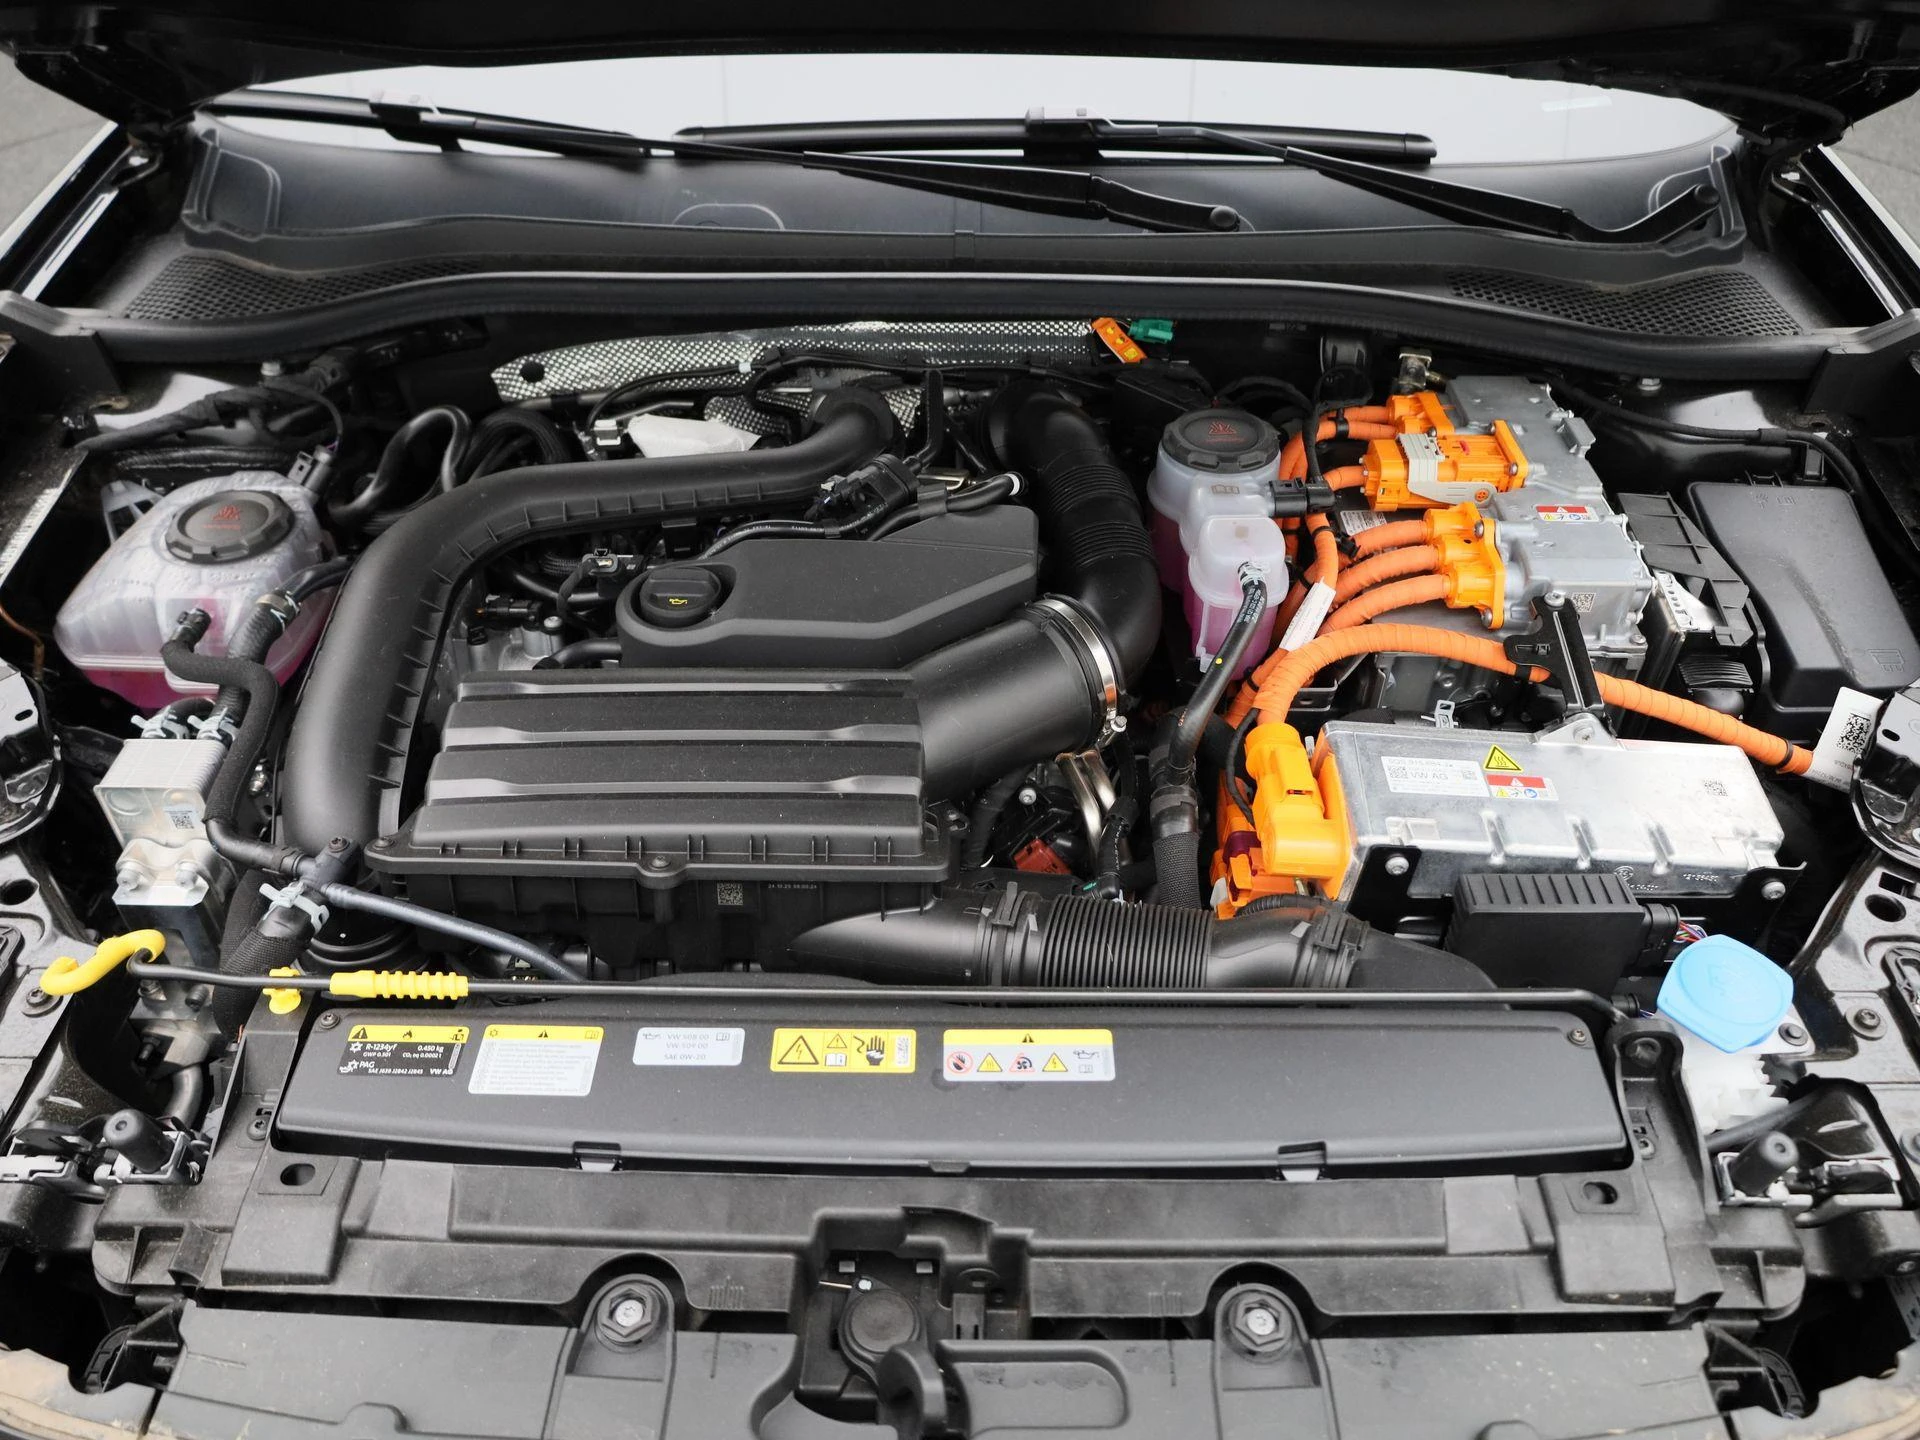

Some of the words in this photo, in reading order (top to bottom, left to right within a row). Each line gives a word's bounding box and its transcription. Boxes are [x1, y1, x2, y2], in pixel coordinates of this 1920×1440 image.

[366, 1044, 397, 1052] R-1234yf
[359, 1060, 375, 1068] PAG
[442, 1068, 454, 1076] AG
